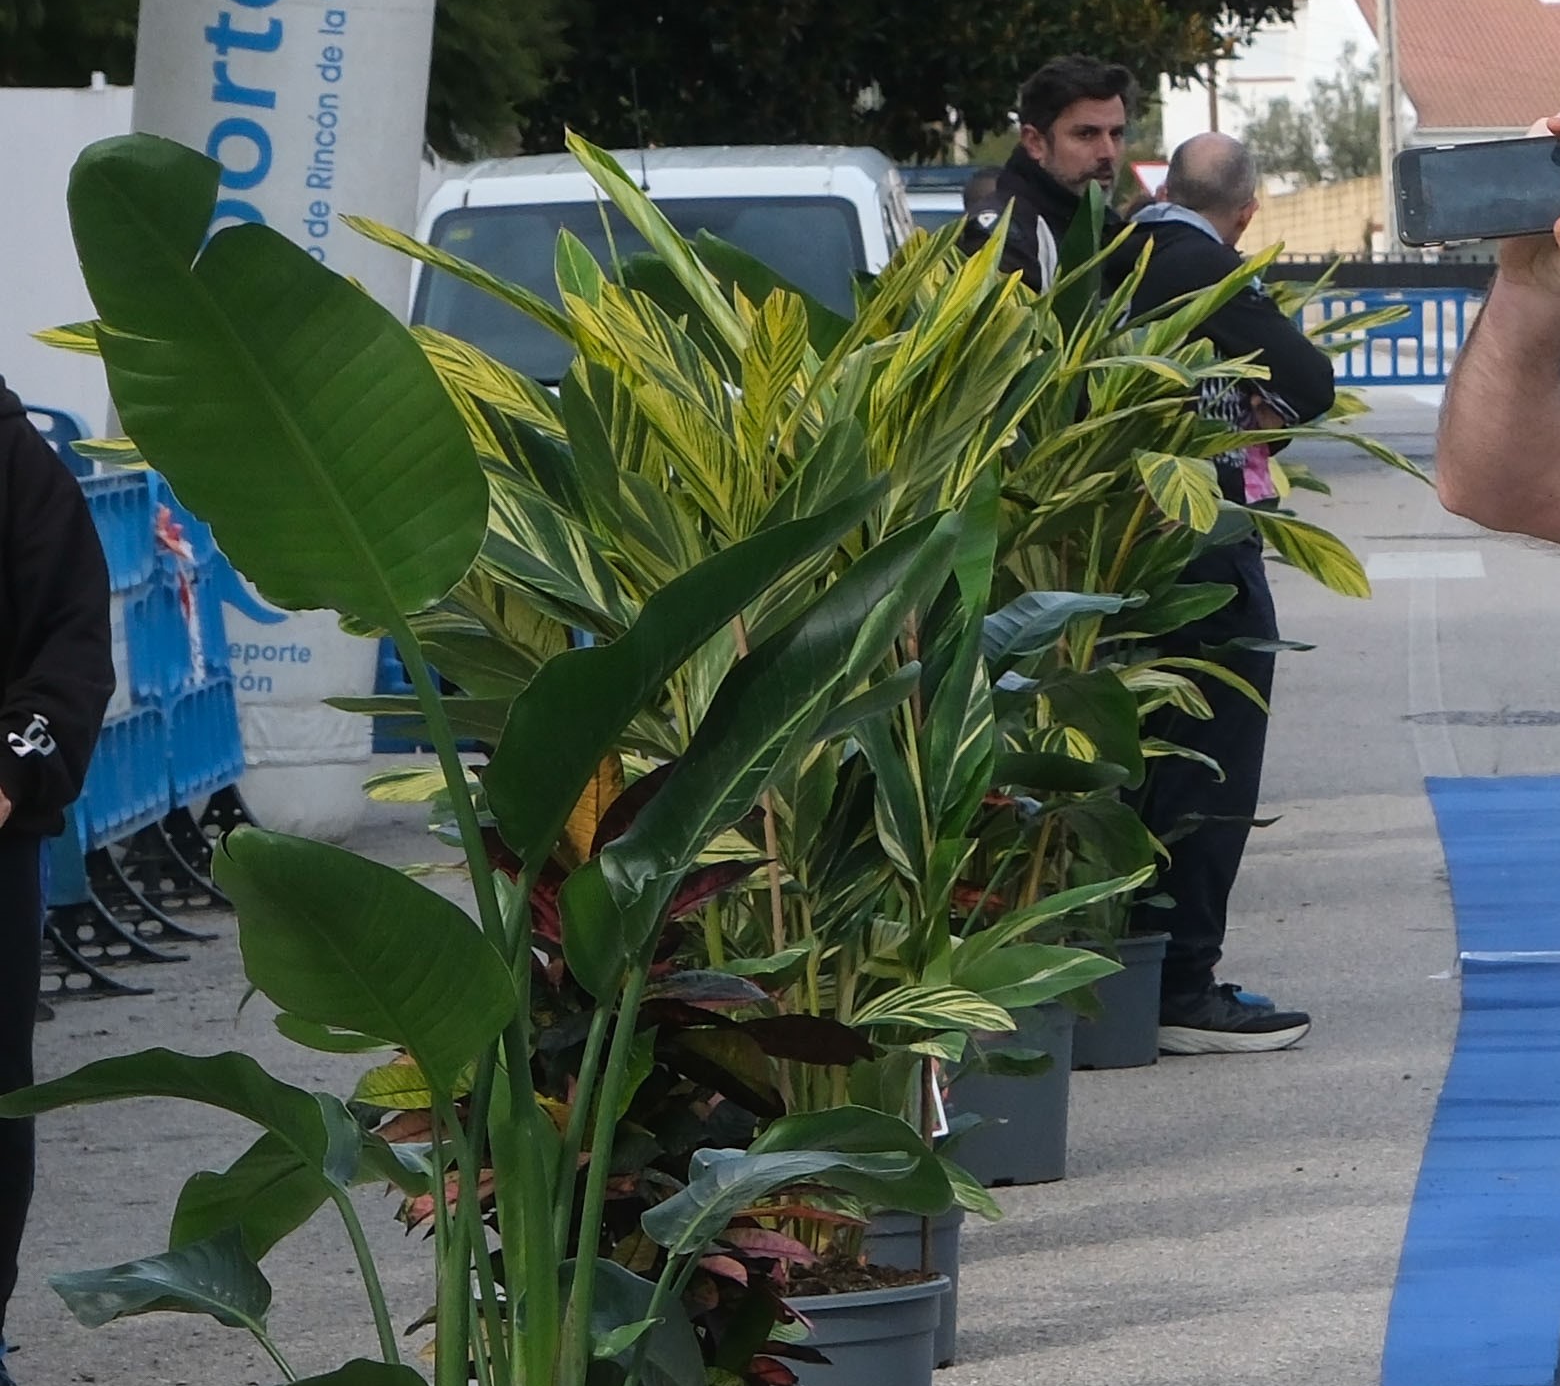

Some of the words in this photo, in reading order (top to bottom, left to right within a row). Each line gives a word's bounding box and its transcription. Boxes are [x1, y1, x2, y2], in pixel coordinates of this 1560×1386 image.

[319, 10, 346, 35] la
[317, 46, 345, 83] de
[307, 94, 340, 192] Rincón
[303, 205, 330, 239] de
[229, 643, 312, 665] eporte
